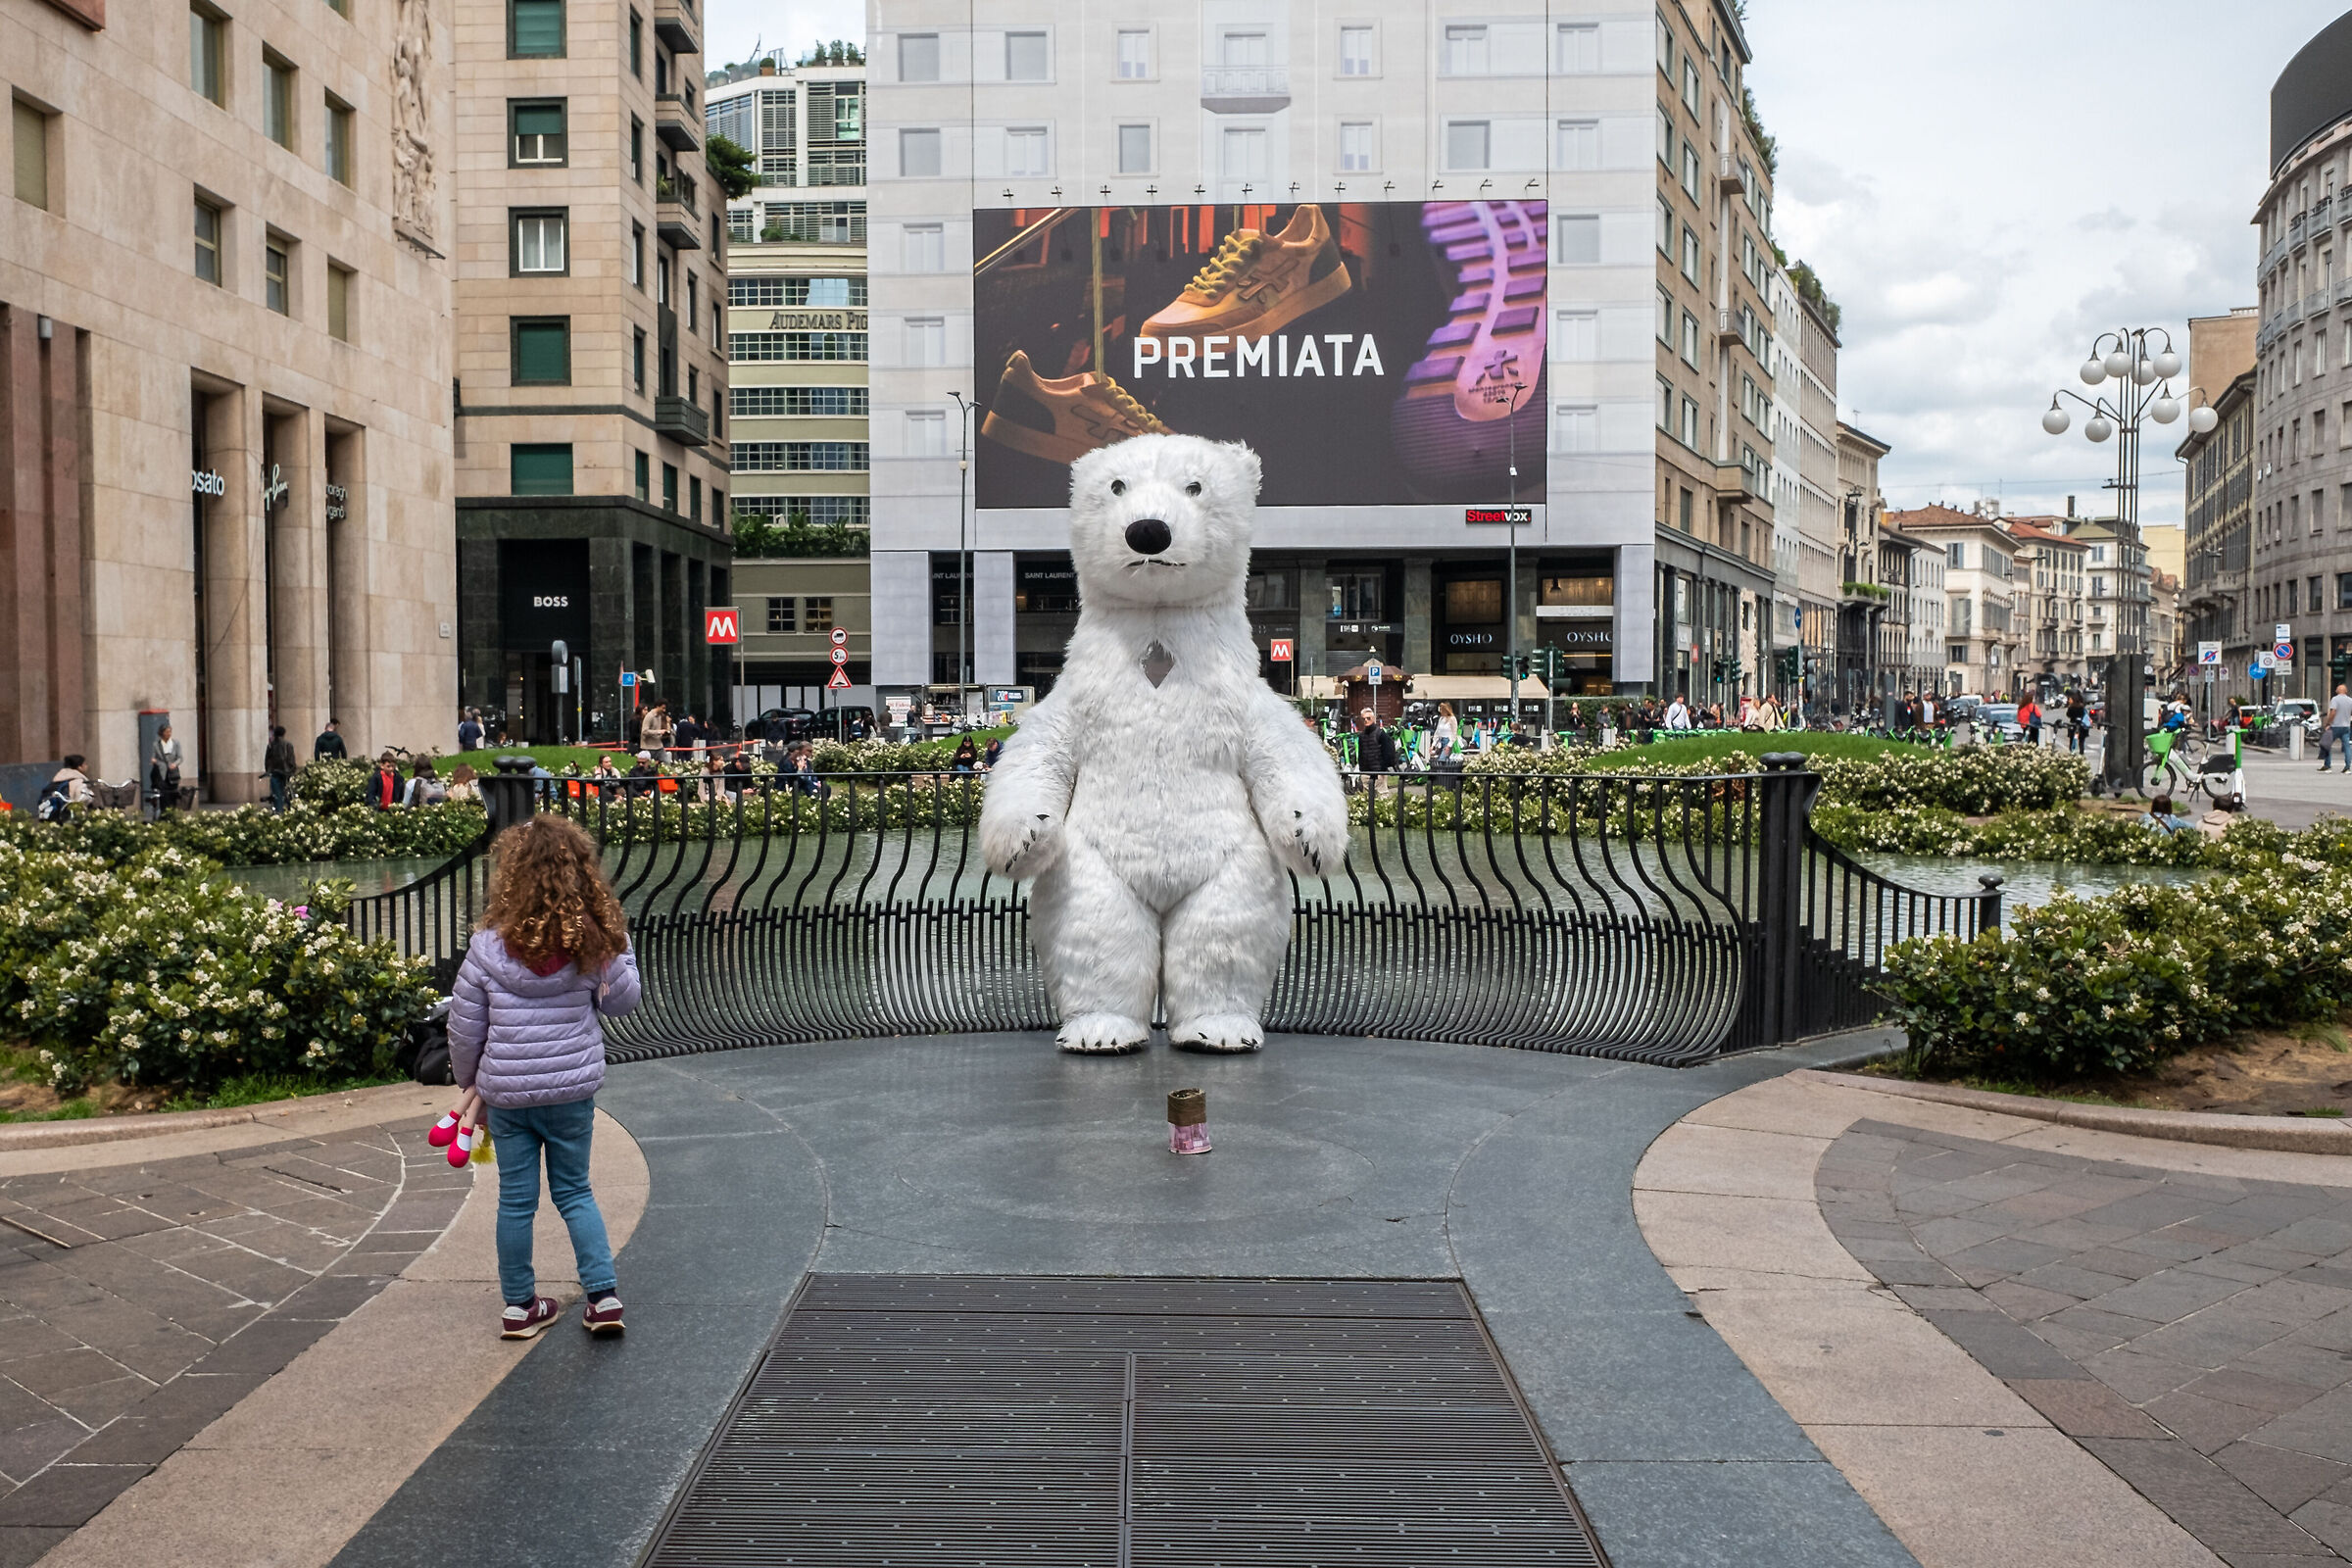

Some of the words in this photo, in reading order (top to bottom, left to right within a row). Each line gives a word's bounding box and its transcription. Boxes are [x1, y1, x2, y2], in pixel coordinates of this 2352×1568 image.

[769, 312, 842, 329] AUDEMARS
[1133, 333, 1385, 378] PREMIATA
[533, 596, 568, 608] BOSS
[709, 616, 735, 637] M
[1450, 633, 1493, 645] OYSHO
[1272, 644, 1289, 657] M
